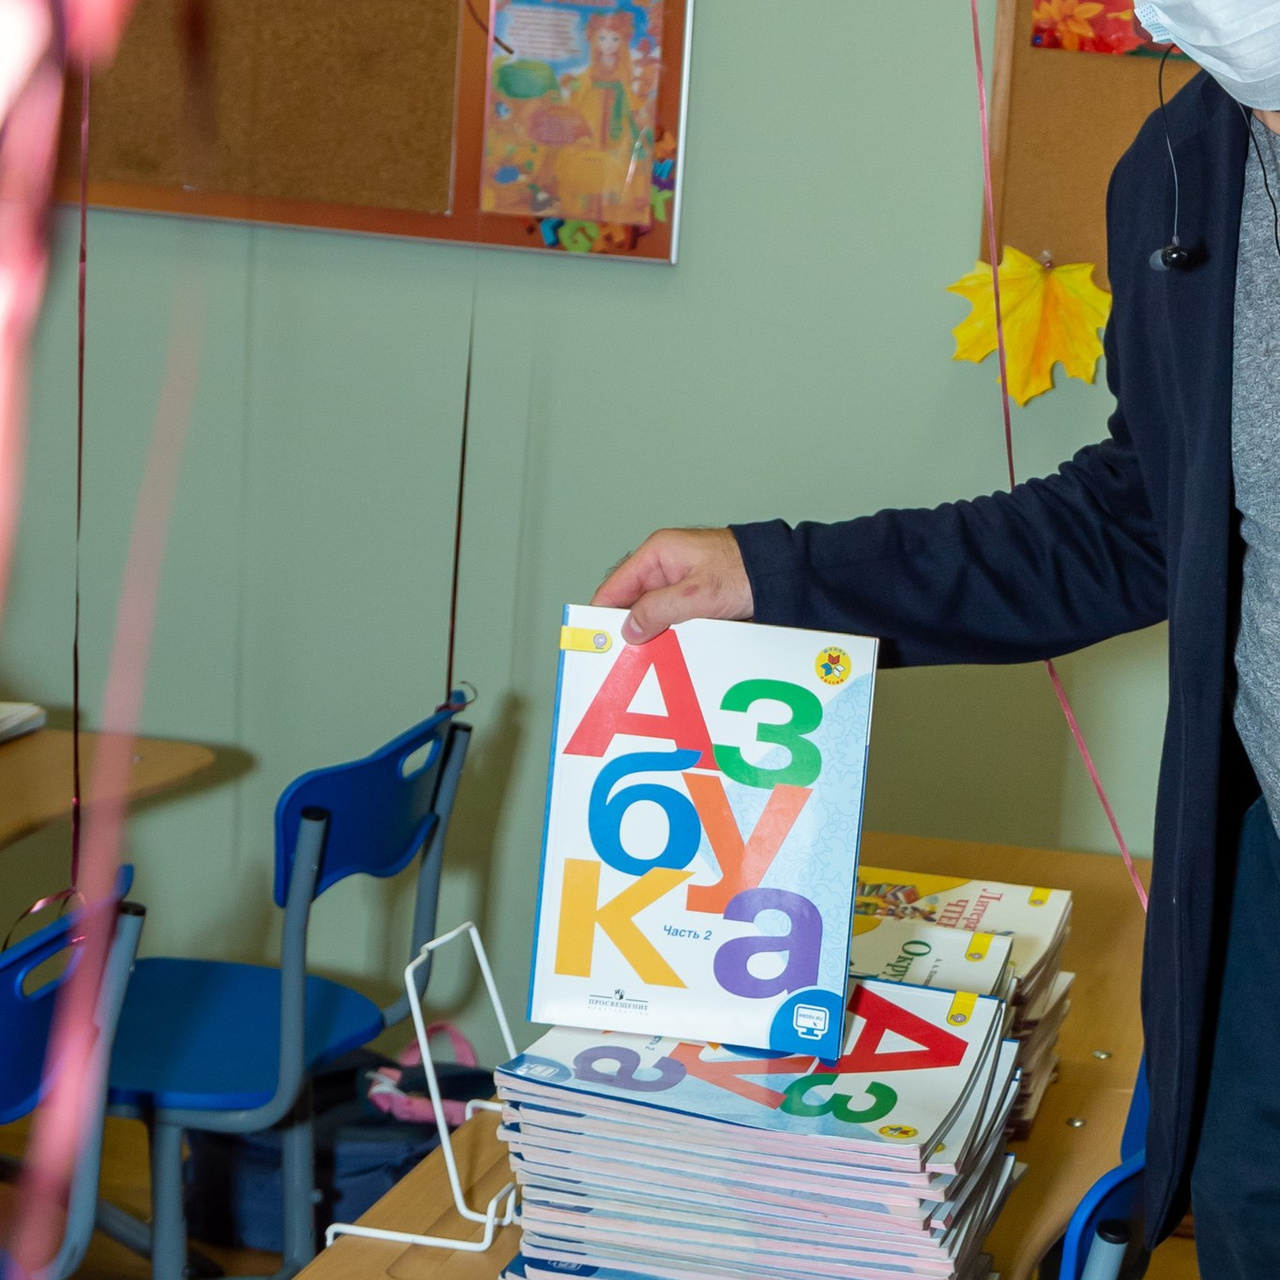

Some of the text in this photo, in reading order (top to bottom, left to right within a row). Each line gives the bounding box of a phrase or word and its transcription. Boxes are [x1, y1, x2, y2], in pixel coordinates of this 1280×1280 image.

[963, 887, 1003, 932] Литера
[663, 924, 713, 941] Часть 2
